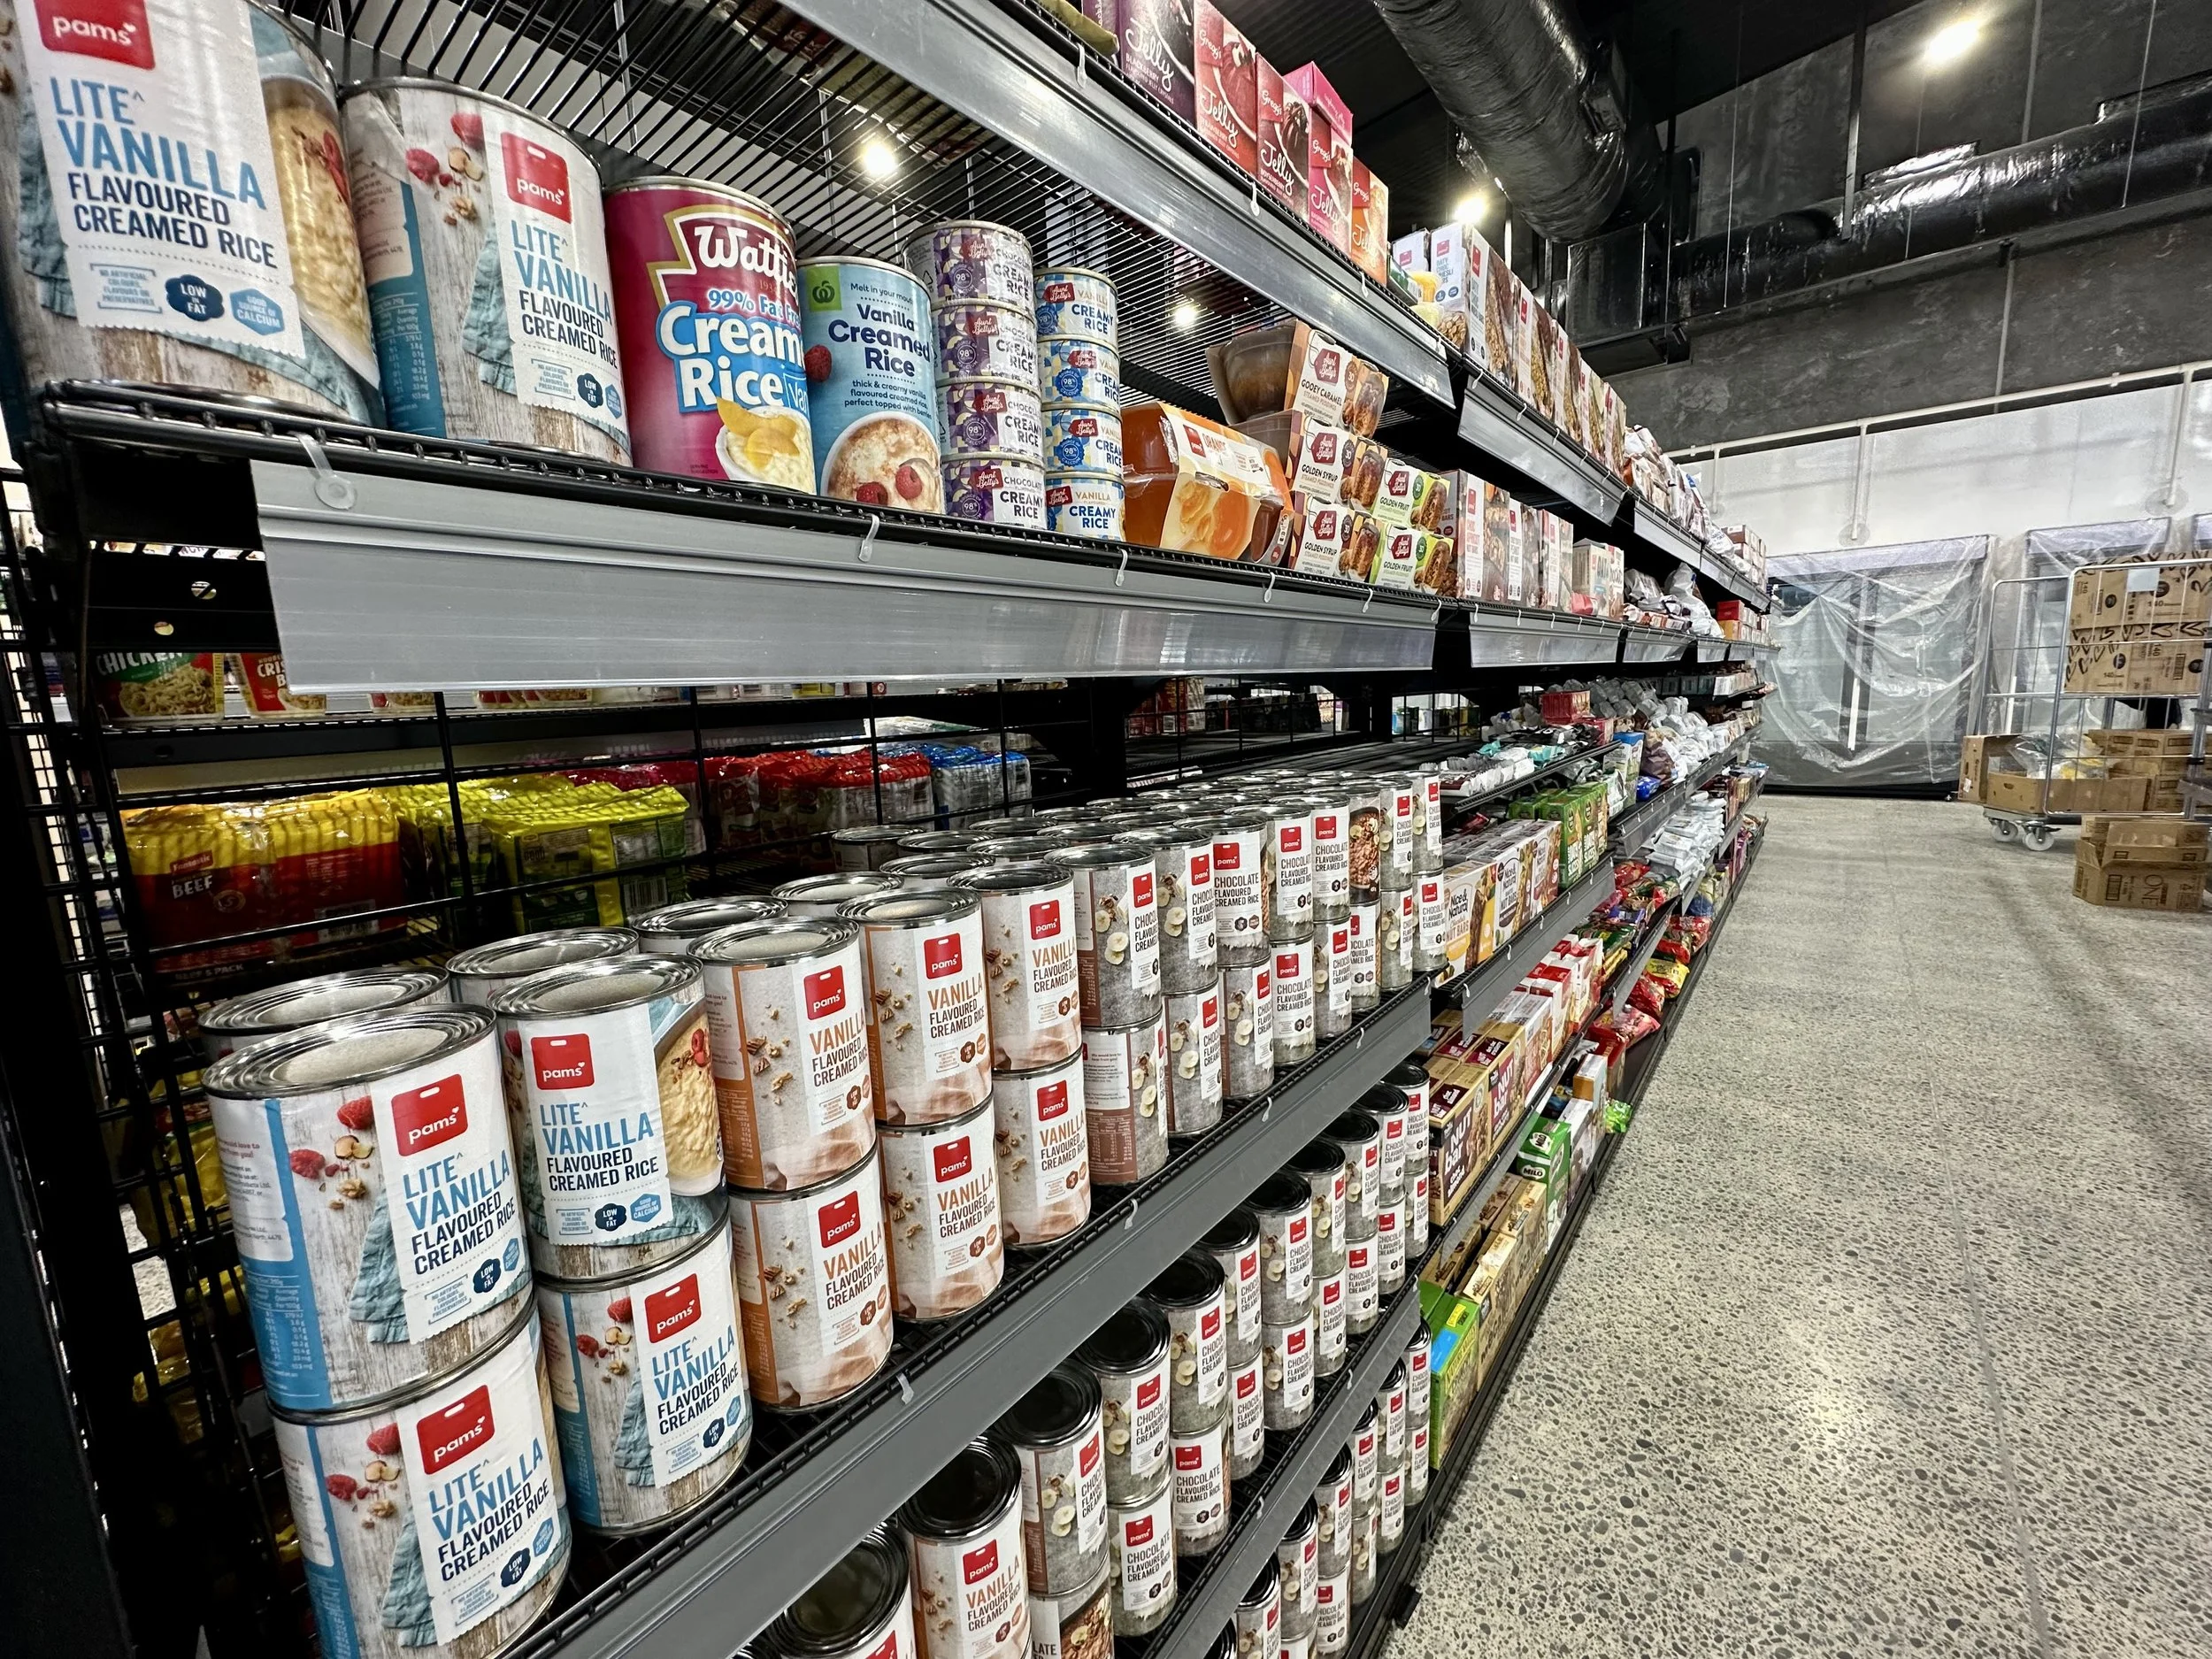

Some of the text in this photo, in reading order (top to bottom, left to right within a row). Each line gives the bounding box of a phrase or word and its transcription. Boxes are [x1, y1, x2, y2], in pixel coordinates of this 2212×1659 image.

[52, 16, 133, 45] pams
[1125, 18, 1174, 92] Jelly
[1199, 29, 1222, 60] Gregg's
[1262, 89, 1282, 116] Gregg's
[1201, 85, 1238, 149] Jelly
[1312, 140, 1330, 162] Gregg's
[57, 119, 265, 211] VANILLA
[1261, 140, 1294, 196] Jelly
[68, 173, 230, 226] FLAVOURED
[517, 178, 563, 205] pams
[74, 204, 278, 269] CREAMED RICE
[180, 282, 206, 298] LOW
[515, 254, 612, 326] VANILLA
[851, 283, 869, 292] Melt
[871, 284, 878, 293] in
[879, 288, 895, 300] your
[188, 303, 206, 314] FAT
[519, 290, 603, 338] FLAVOURED
[708, 289, 755, 311] 99%
[760, 296, 783, 317] Fat
[236, 309, 280, 328] CALCIUM
[856, 303, 915, 331] Vanilla
[1071, 304, 1113, 326] CREAMY
[1085, 318, 1108, 334] RICE
[522, 313, 618, 369] CREAMED RICE
[828, 319, 931, 363] Creamed
[864, 347, 915, 377] Rice
[1010, 354, 1033, 373] RICE
[585, 380, 596, 390] LOW
[678, 356, 783, 407] Rice
[881, 384, 908, 394] creamy
[909, 388, 926, 399] vanilla
[588, 393, 596, 403] FAT
[851, 389, 887, 398] flavoured
[889, 394, 918, 404] creamed
[984, 395, 1000, 404] Aunt
[1105, 387, 1119, 404] RICE
[1302, 380, 1342, 406] GOOEY CARAMEL
[844, 399, 872, 408] perfect
[875, 400, 901, 410] topped
[902, 403, 916, 413] with
[1018, 430, 1039, 447] RICE
[1106, 453, 1122, 468] RICE
[979, 472, 995, 480] Aunt
[1302, 464, 1338, 482] GOLDEN SYRUP
[1000, 491, 1043, 508] CREAMY
[1076, 491, 1111, 502] VANILLA
[1380, 497, 1397, 508] GOLDEN
[1014, 505, 1038, 518] RICE
[1069, 506, 1116, 518] CREAMY
[1082, 518, 1109, 529] RICE
[1304, 541, 1338, 556] GOLDEN SYRUP
[1384, 561, 1401, 571] GOLDEN
[172, 874, 212, 899] BEEF
[1215, 872, 1259, 887] CHOCOLATE
[1215, 887, 1251, 897] FLAVOURED
[1248, 895, 1259, 903] RICE
[1451, 894, 1462, 906] Nice
[1448, 899, 1468, 920] Natural
[1457, 920, 1469, 936] BARS
[932, 959, 957, 973] pams
[928, 972, 983, 1010] VANILLA
[1277, 978, 1312, 995] CHOCOLATE
[1277, 992, 1308, 1003] FLAVOURED
[929, 999, 978, 1025] FLAVOURED
[1277, 1002, 1304, 1011] CREAMED
[930, 1013, 973, 1039] CREAMED
[542, 1066, 582, 1081] pams
[1498, 1058, 1514, 1102] NUT
[1494, 1090, 1508, 1118] bar
[408, 1113, 457, 1144] pams
[542, 1112, 654, 1155] VANILLA
[1451, 1107, 1472, 1153] NUT
[547, 1147, 633, 1173] FLAVOURED
[1444, 1141, 1463, 1175] bar
[549, 1156, 658, 1191] CREAMED RICE
[1524, 1168, 1543, 1177] MILO
[406, 1150, 510, 1230] VANILLA
[603, 1209, 618, 1217] LOW
[634, 1205, 659, 1218] CALCIUM
[411, 1191, 502, 1255] FLAVOURED
[827, 1218, 855, 1240] pams
[414, 1196, 515, 1275] CREAMED RICE
[823, 1222, 882, 1280] VANILLA
[480, 1263, 494, 1278] LOW
[826, 1253, 877, 1296] FLAVOURED
[484, 1278, 494, 1288] FAT
[827, 1278, 872, 1310] CREAMED
[433, 1424, 482, 1463] pams
[1176, 1463, 1220, 1486] CHOCOLATE
[1179, 1459, 1197, 1468] pams
[431, 1438, 543, 1541] VANILLA
[1176, 1480, 1213, 1495] FLAVOURED
[1176, 1490, 1208, 1504] CREAMED
[438, 1482, 532, 1563] FLAVOURED
[442, 1479, 549, 1582] CREAMED RICE
[969, 1561, 994, 1580] pams
[966, 1555, 1020, 1609] VANILLA
[967, 1582, 1013, 1621] FLAVOURED
[968, 1601, 1008, 1632] CREAMED
